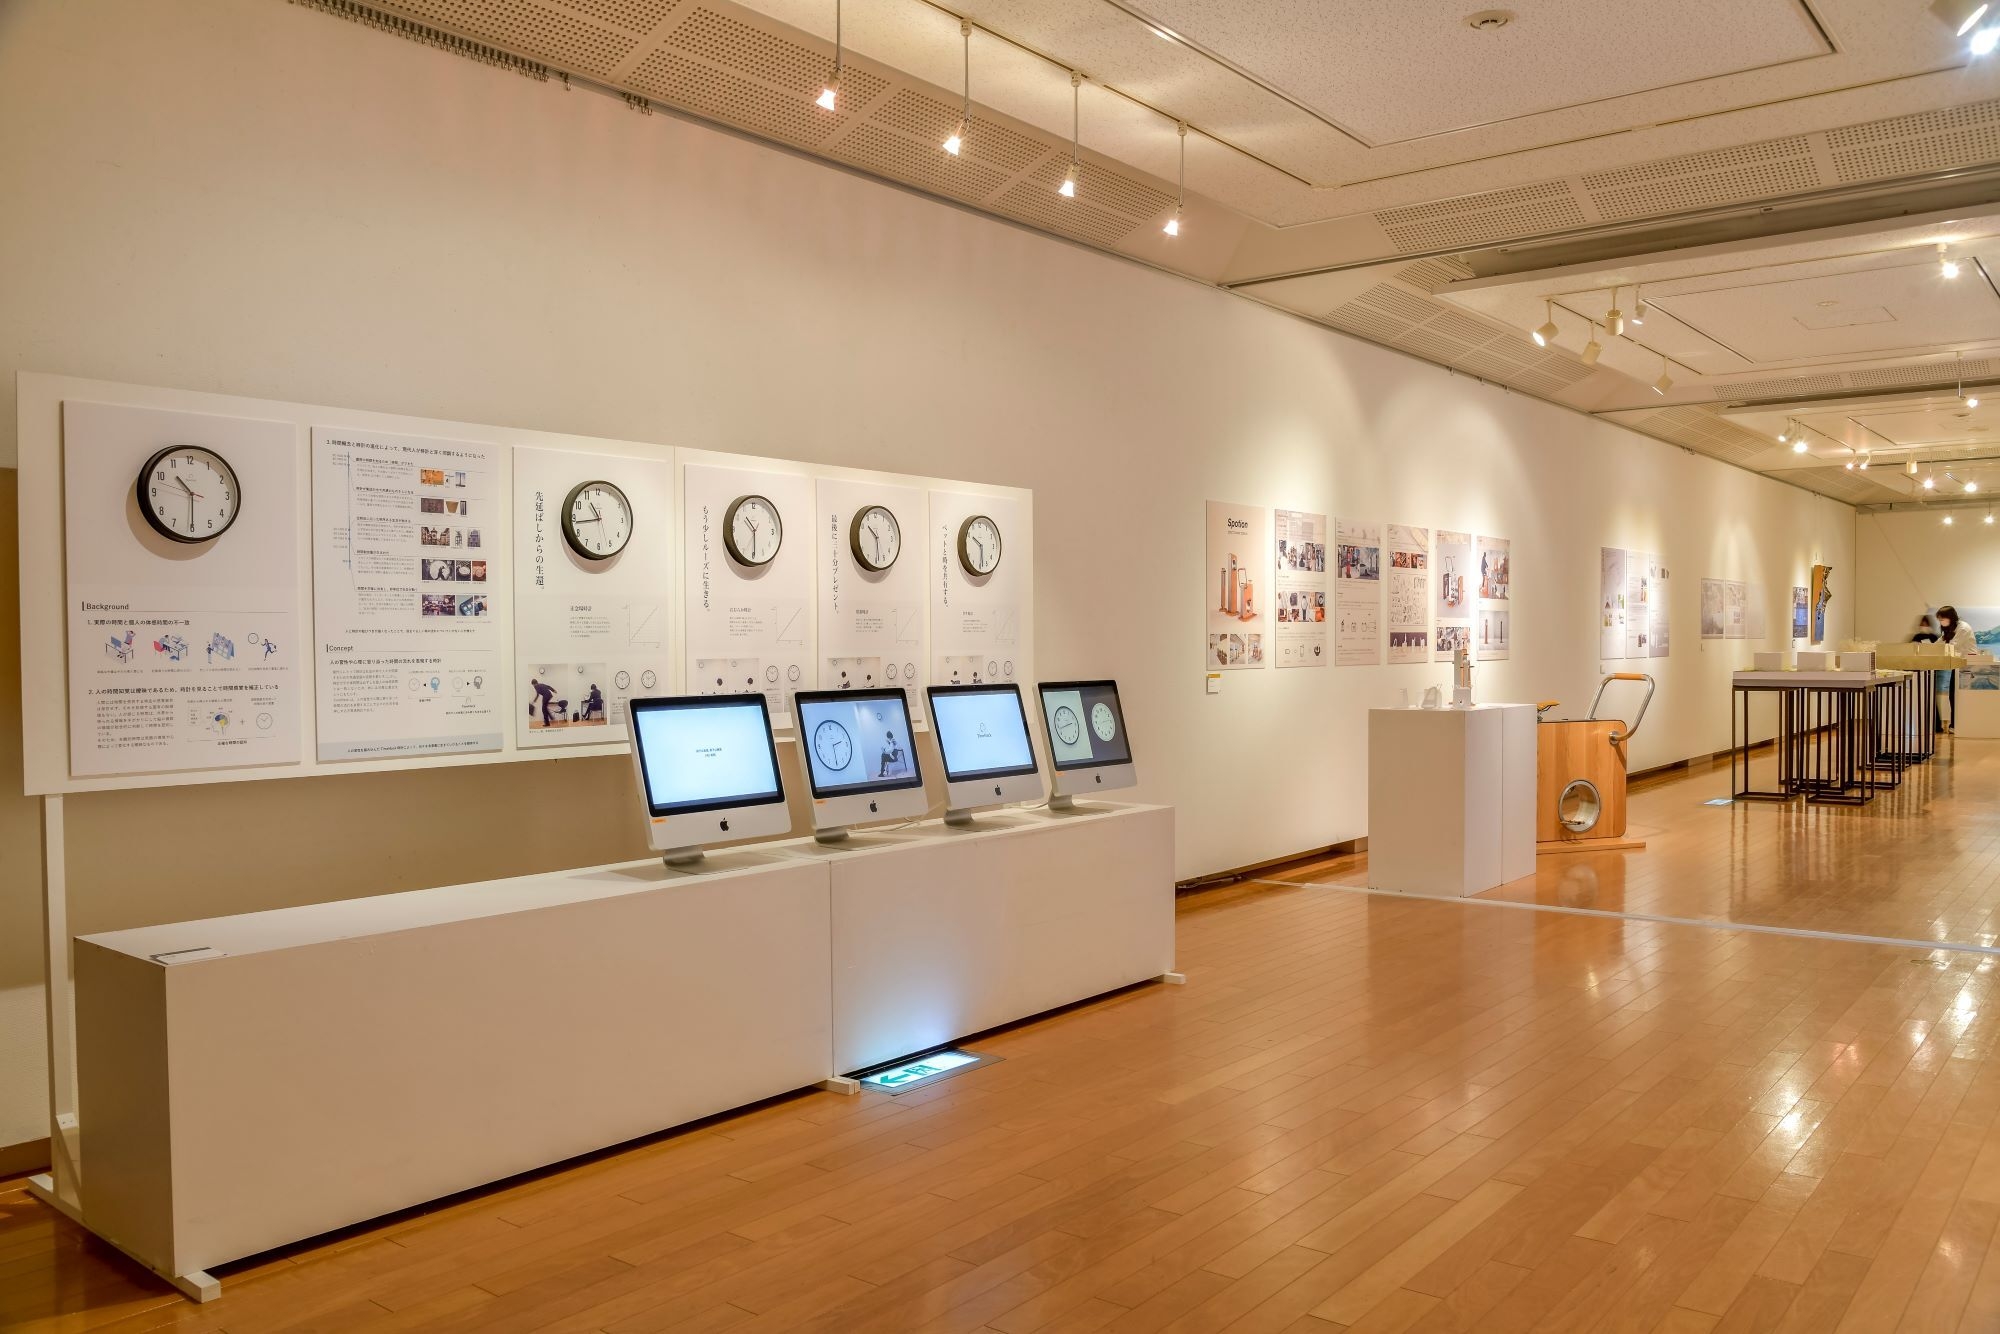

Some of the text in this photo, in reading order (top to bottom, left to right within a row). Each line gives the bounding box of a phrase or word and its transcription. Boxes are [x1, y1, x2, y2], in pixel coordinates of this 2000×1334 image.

[170, 459, 177, 468] 11
[186, 455, 194, 465] 12
[206, 461, 210, 470] 1
[156, 471, 165, 481] 10
[219, 475, 224, 484] 2
[151, 487, 157, 497] 9
[225, 491, 230, 500] 3
[584, 490, 590, 501] 11
[595, 488, 601, 496] 12
[575, 500, 582, 510] 10
[159, 506, 164, 515] 8
[219, 508, 224, 518] 4
[172, 518, 177, 527] 7
[207, 519, 213, 528] 5
[189, 523, 195, 532] 6
[535, 491, 545, 590] 先延ばしからの生還。
[584, 538, 589, 546] 7
[86, 602, 129, 611] Background
[329, 645, 353, 653] Concept
